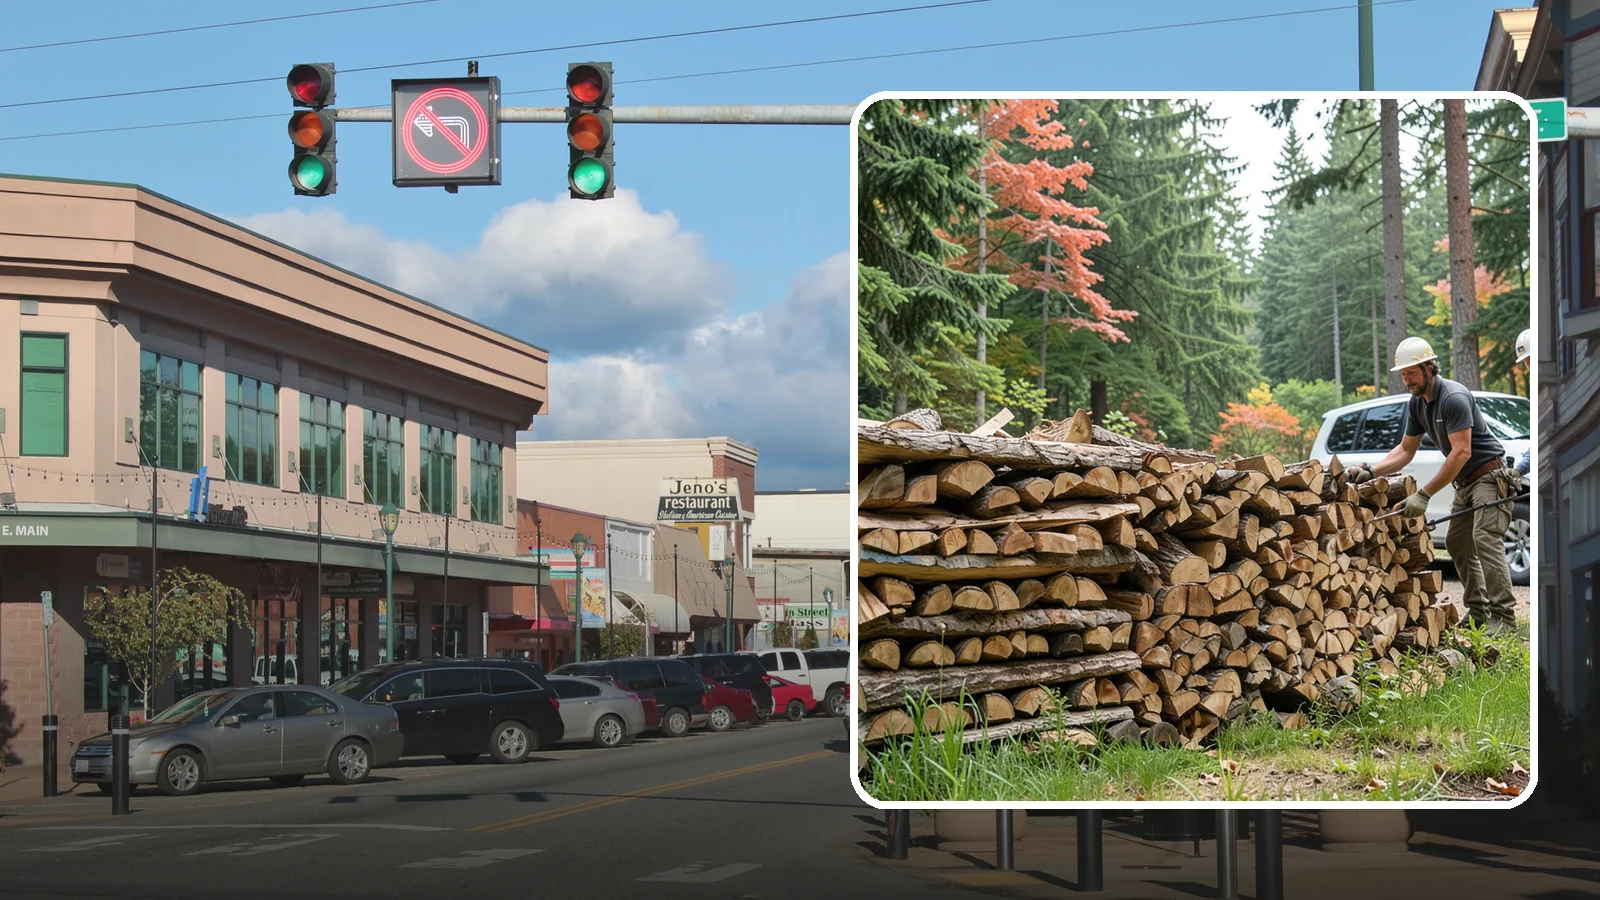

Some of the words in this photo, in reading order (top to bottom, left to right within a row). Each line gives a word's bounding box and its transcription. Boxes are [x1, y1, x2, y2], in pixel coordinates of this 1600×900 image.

[670, 480, 727, 494] Jeno's
[665, 496, 731, 509] restaurant
[658, 510, 682, 520] Italian
[686, 509, 714, 519] American
[715, 509, 737, 519] Cuisine
[2, 525, 13, 536] E.
[15, 525, 48, 536] MAIN
[797, 607, 828, 616] Street
